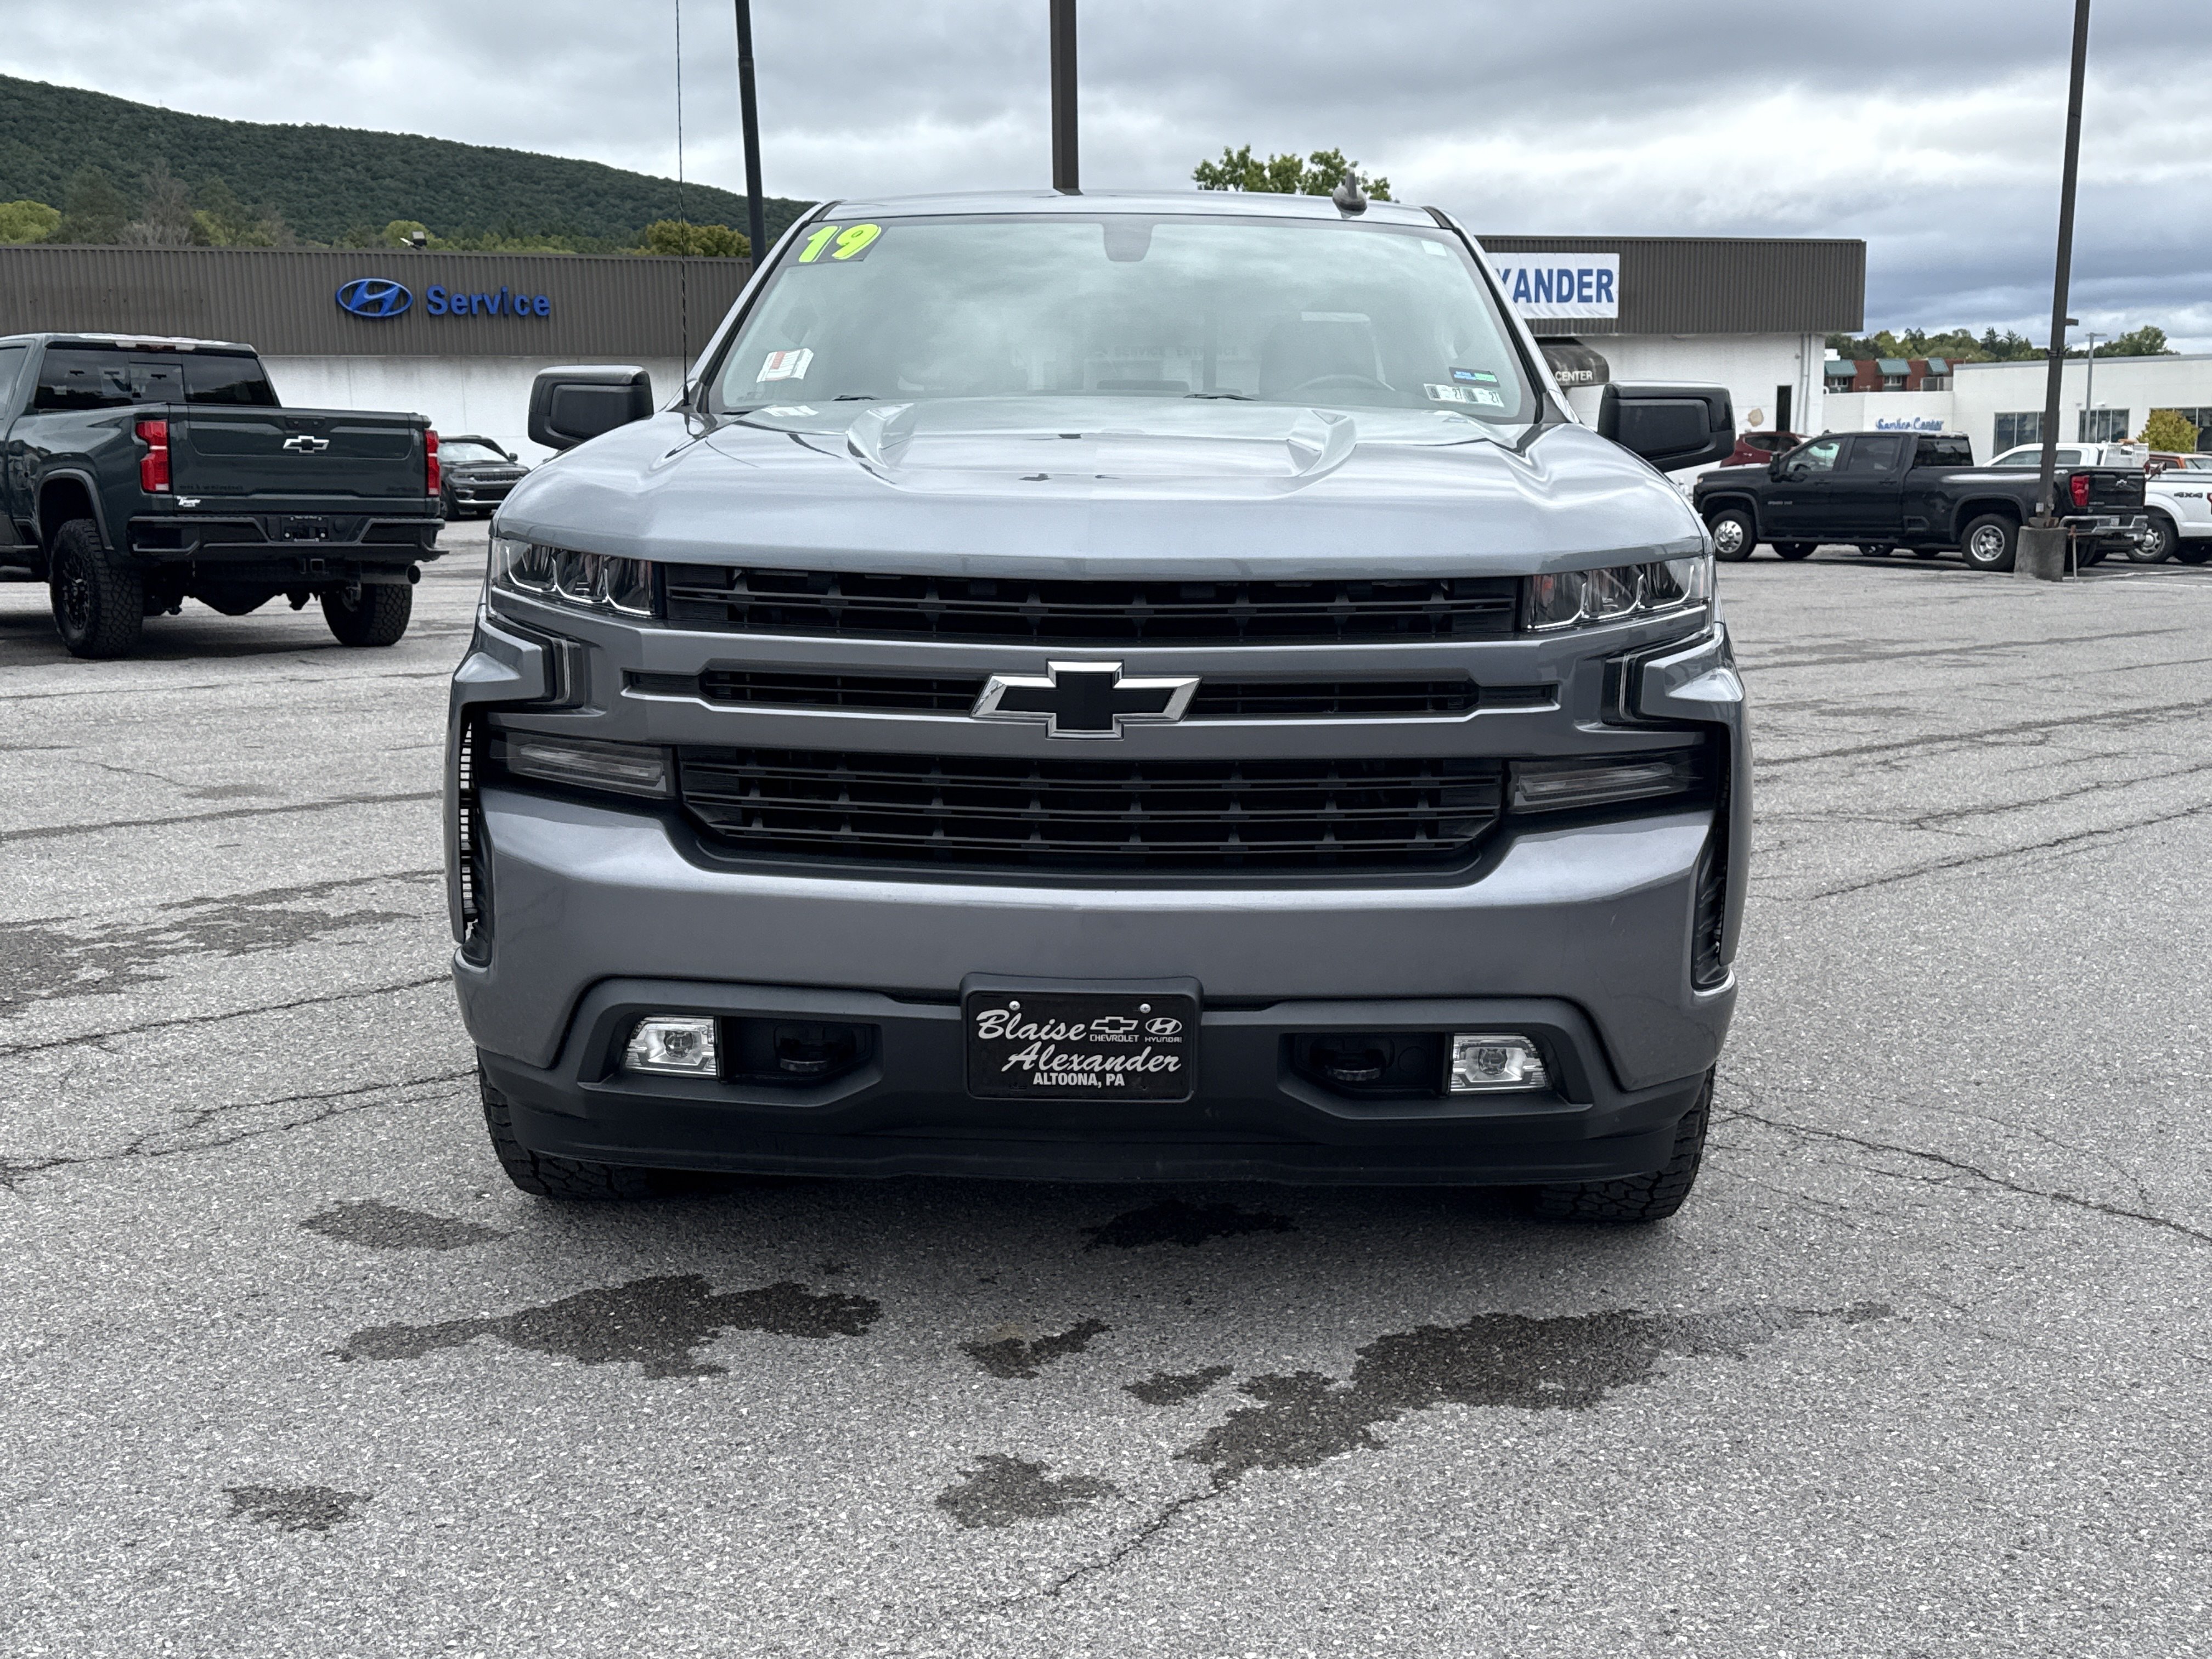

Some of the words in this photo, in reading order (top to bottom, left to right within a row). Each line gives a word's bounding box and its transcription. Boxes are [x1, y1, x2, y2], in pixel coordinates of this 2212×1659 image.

[799, 223, 882, 263] 19
[426, 284, 551, 317] Service
[1555, 370, 1593, 382] CENTER
[976, 1009, 1087, 1040] Blaise
[1090, 1034, 1139, 1042] CHEVROLET
[1001, 1041, 1182, 1072] Alexander
[1033, 1072, 1102, 1088] ALTOONA,
[1106, 1073, 1125, 1086] PA
